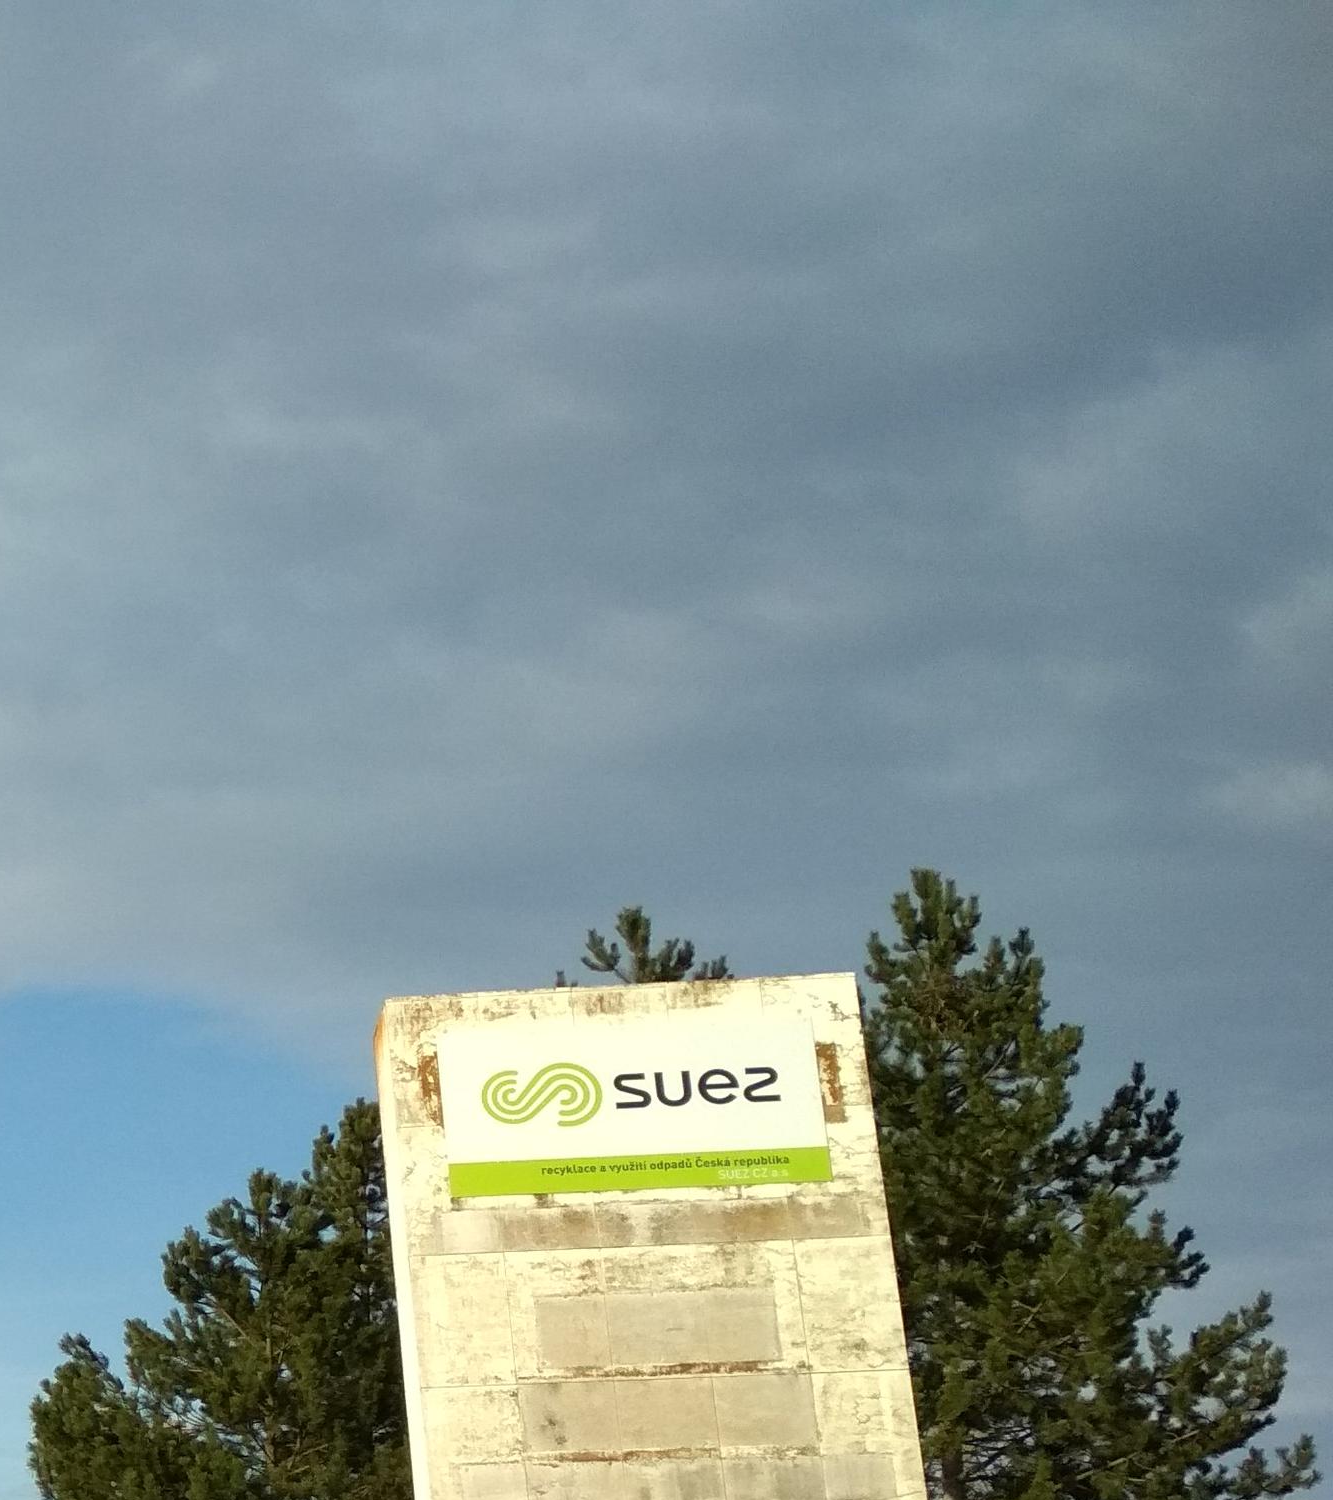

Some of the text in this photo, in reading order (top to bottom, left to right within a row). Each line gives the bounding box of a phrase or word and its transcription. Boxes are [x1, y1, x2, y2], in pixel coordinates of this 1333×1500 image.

[541, 1155, 790, 1176] recyklace a využití odpadů Česká republika
[718, 1168, 750, 1180] SUEZ
